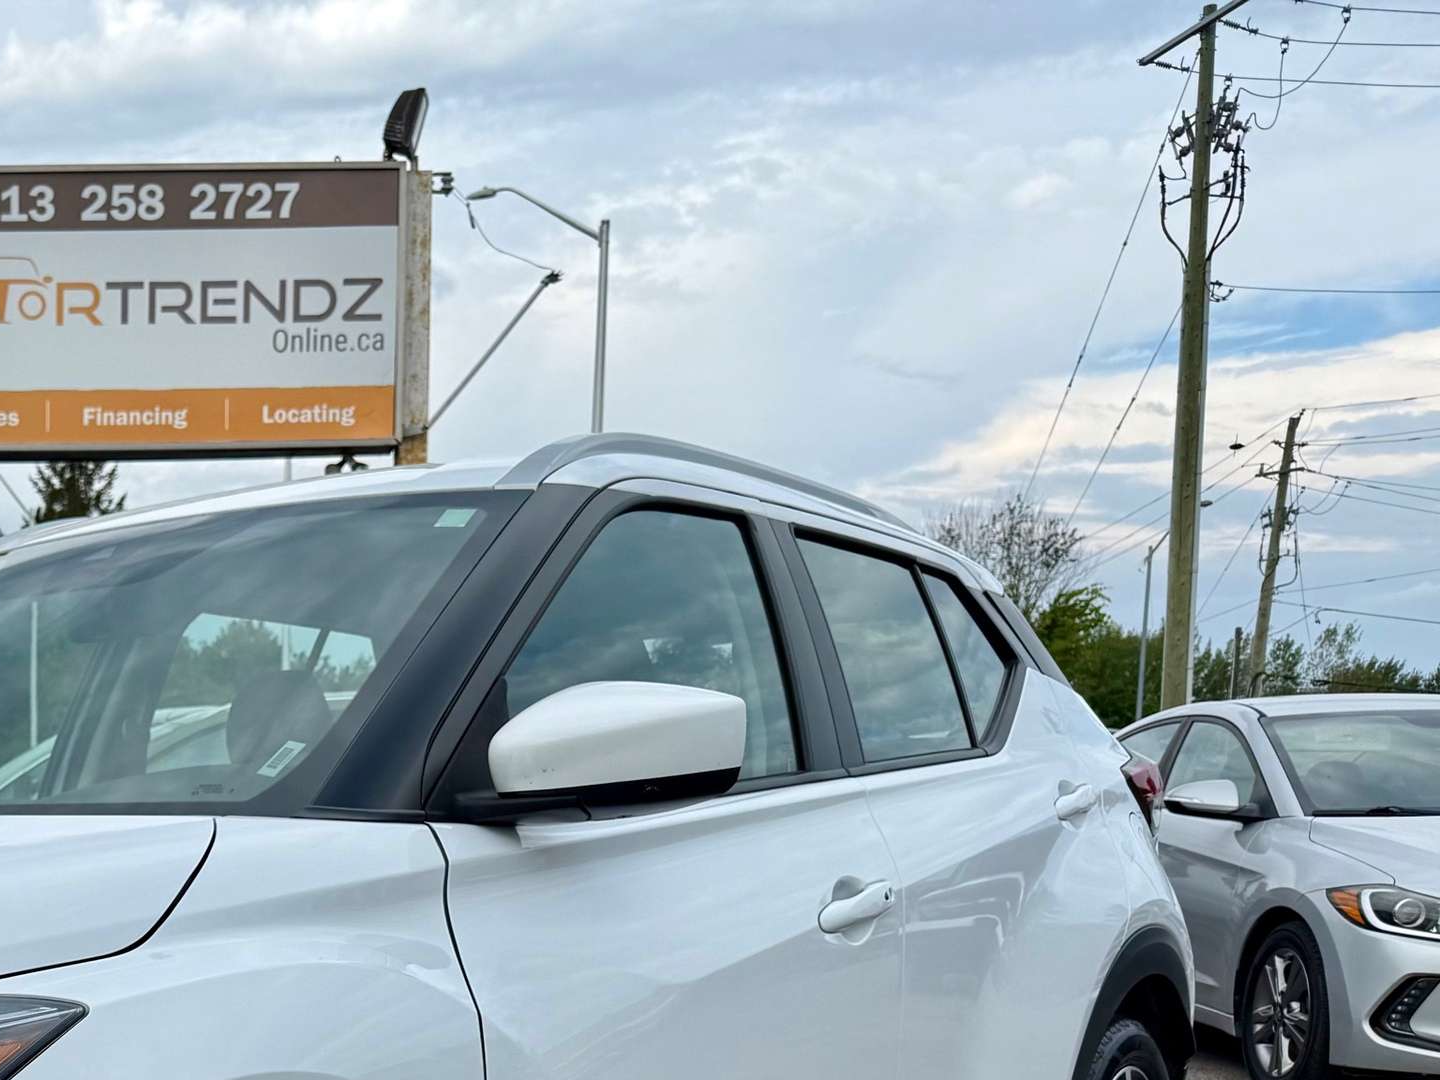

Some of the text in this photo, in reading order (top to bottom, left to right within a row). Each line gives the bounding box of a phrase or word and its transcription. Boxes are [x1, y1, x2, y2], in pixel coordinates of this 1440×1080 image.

[80, 183, 165, 222] 258
[189, 182, 301, 220] 2727
[272, 328, 386, 354] Online.ca
[82, 406, 189, 429] Financing
[261, 403, 356, 426] Locating
